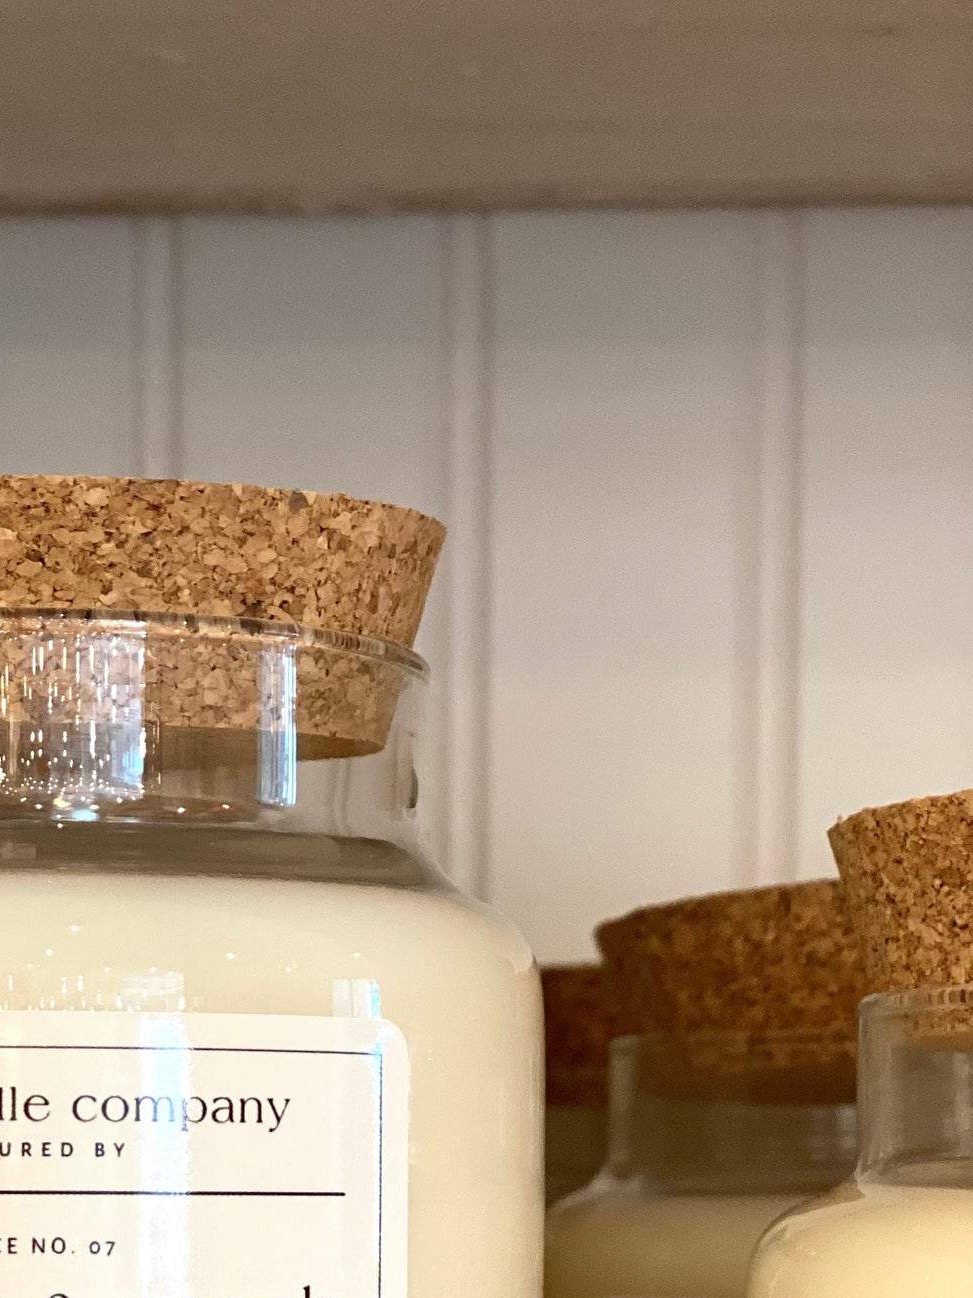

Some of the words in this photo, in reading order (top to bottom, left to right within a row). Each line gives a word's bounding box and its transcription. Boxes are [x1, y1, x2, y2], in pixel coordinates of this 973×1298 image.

[71, 1094, 292, 1132] company
[94, 1141, 126, 1158] BY
[31, 1236, 76, 1255] NO.
[88, 1240, 116, 1257] 07
